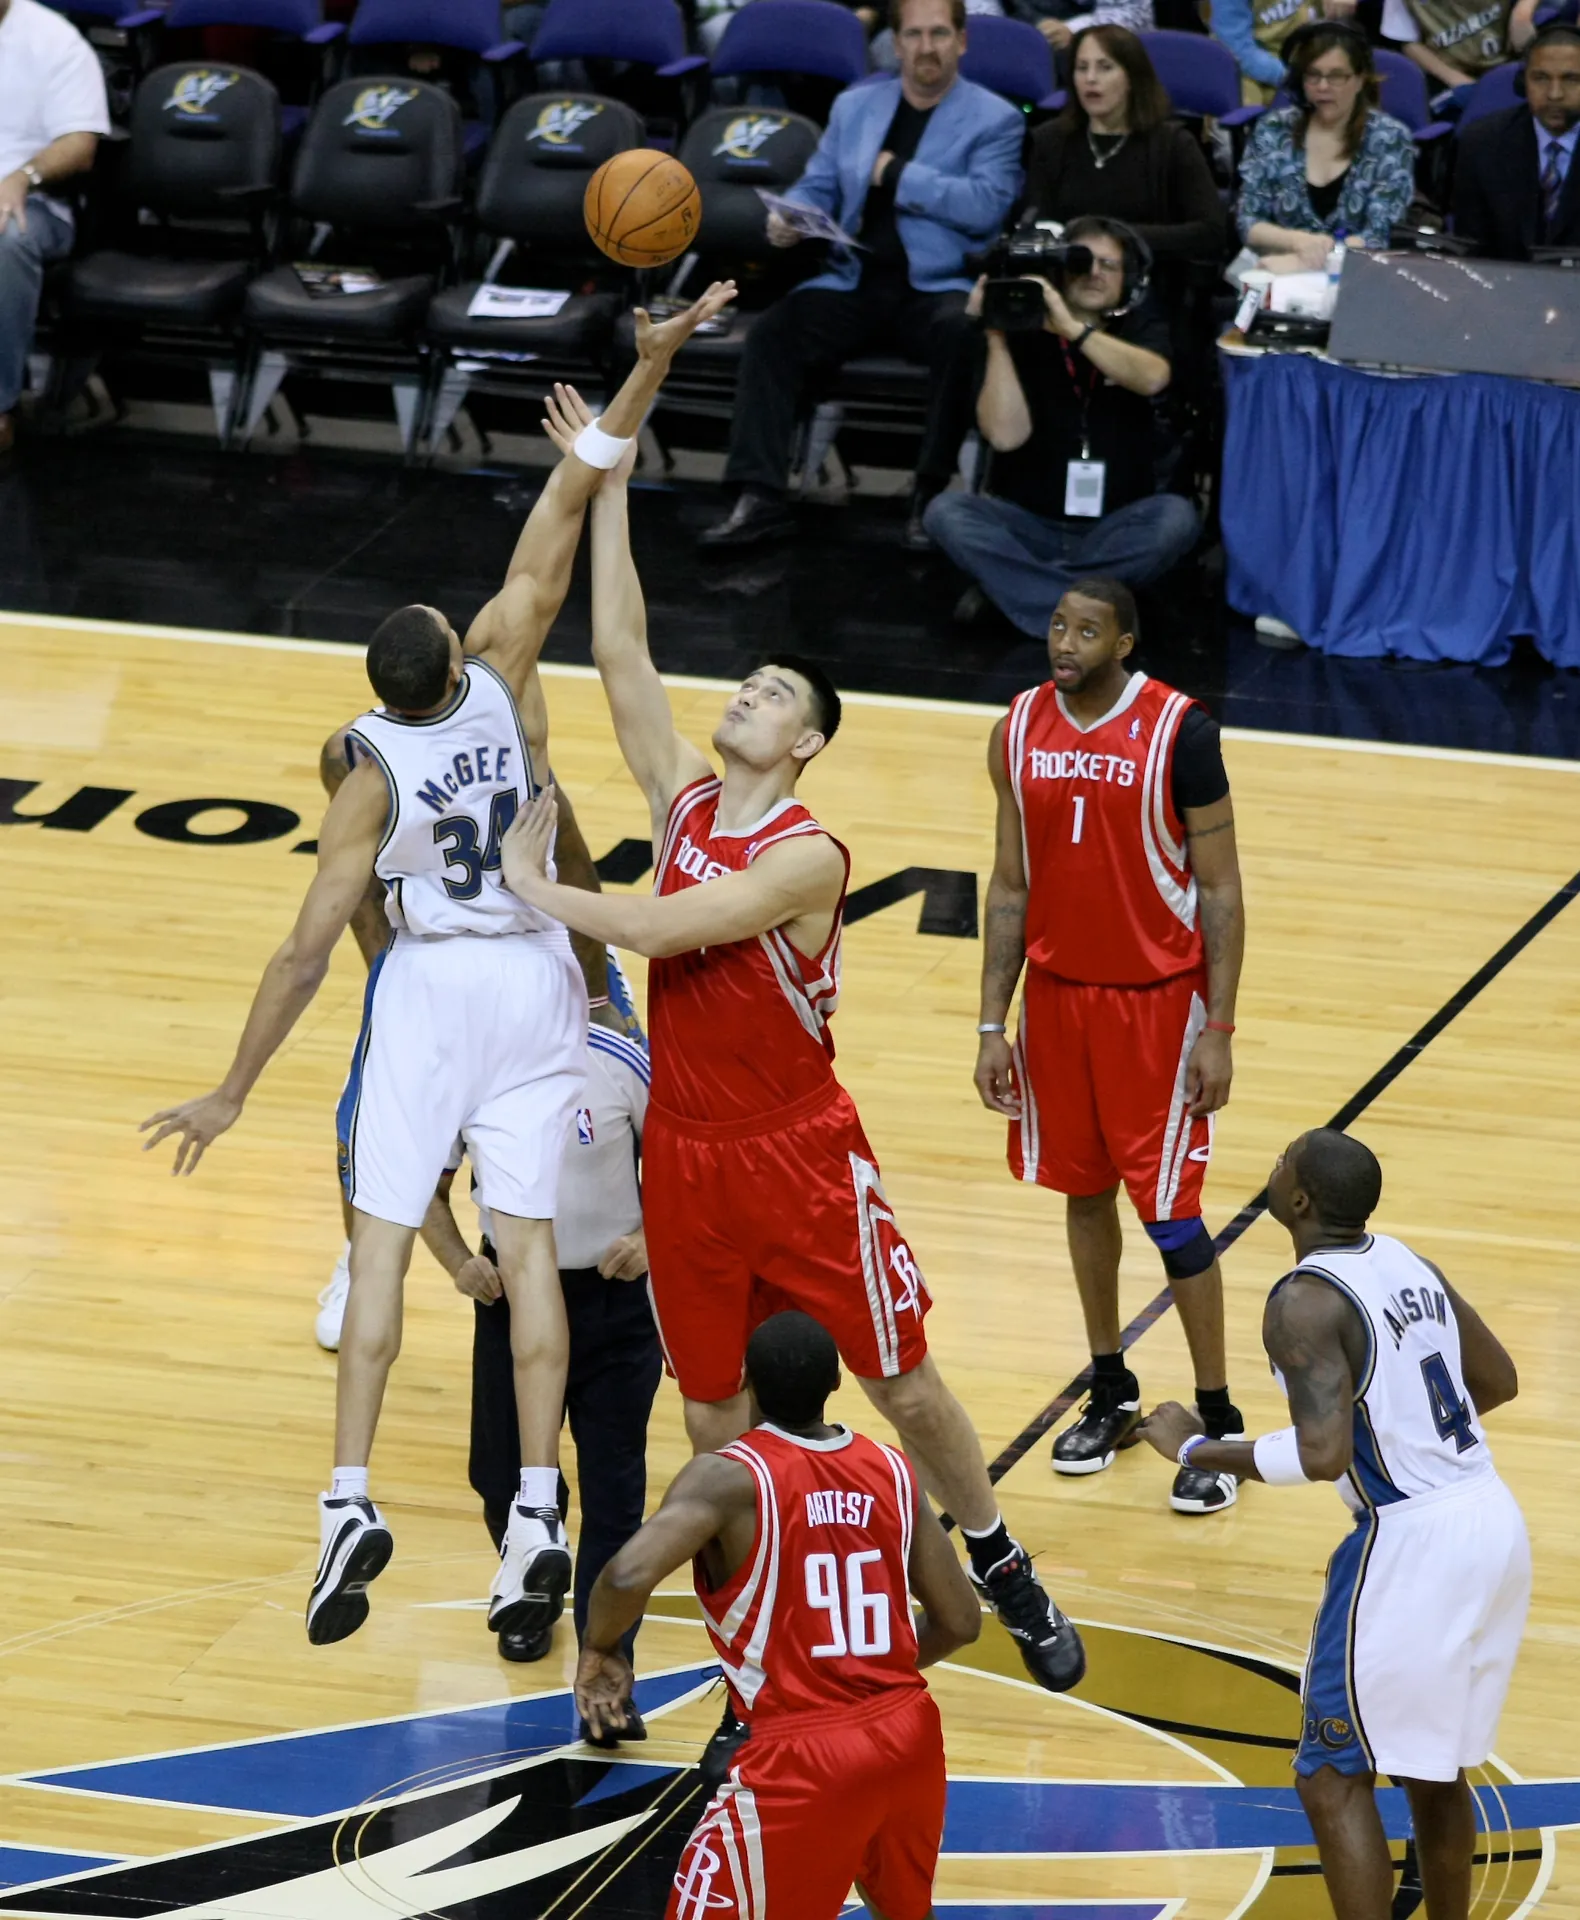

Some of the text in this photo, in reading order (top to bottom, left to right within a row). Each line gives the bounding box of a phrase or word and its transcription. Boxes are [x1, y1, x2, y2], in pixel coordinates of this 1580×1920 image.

[416, 747, 512, 816] McGEE
[1028, 747, 1136, 787] ROCKETS
[433, 787, 518, 900] 34
[1071, 796, 1085, 844] 1
[1420, 1351, 1479, 1455] 4
[805, 1490, 874, 1529] ARTEST
[804, 1549, 891, 1658] 96
